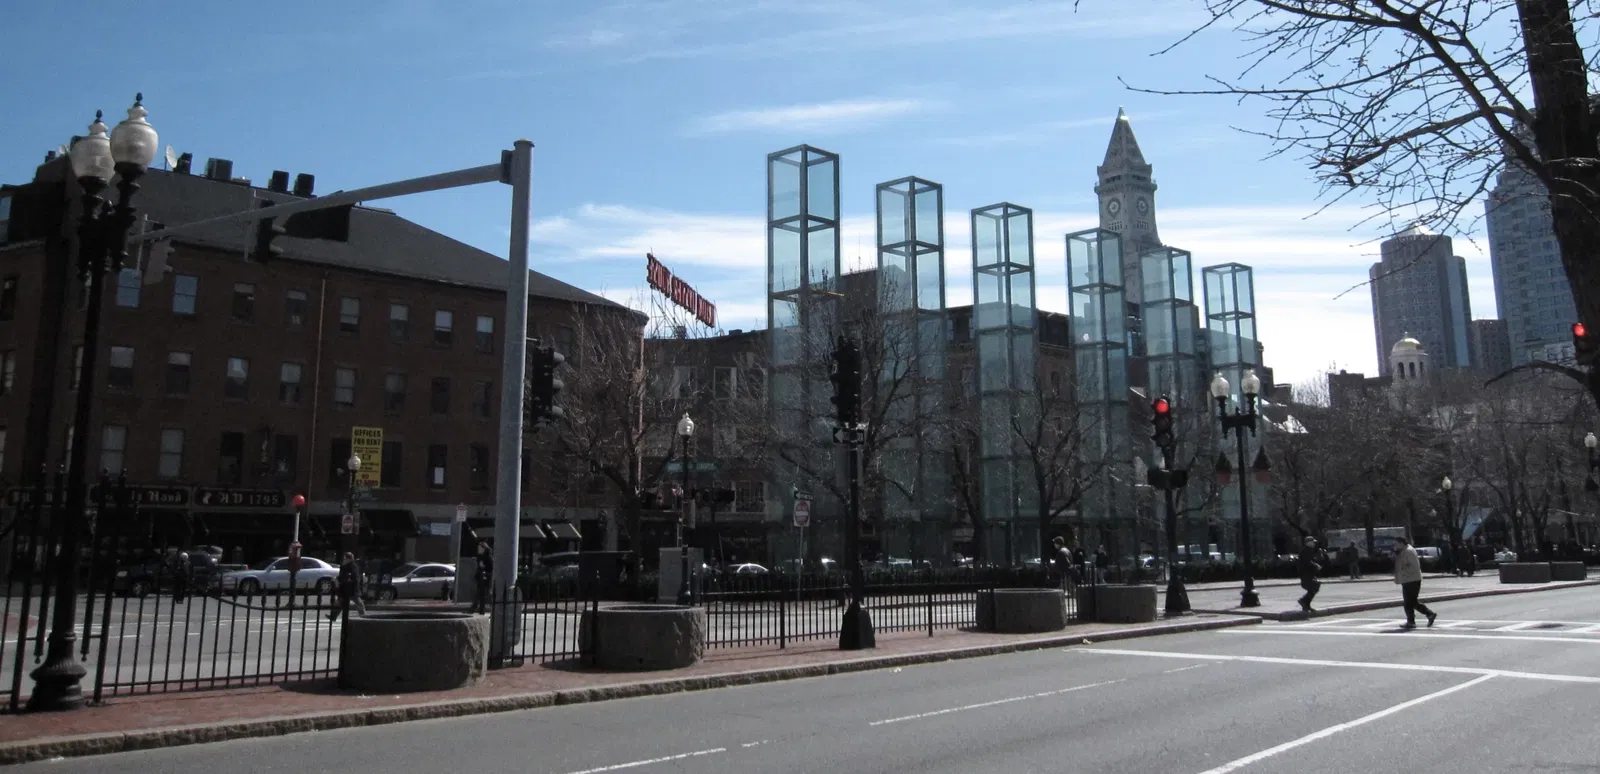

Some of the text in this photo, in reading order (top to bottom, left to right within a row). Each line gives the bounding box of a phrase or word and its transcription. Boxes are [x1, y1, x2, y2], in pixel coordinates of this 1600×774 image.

[354, 429, 381, 437] OFFICES
[353, 437, 381, 446] FOR RENT
[249, 492, 279, 505] 1795
